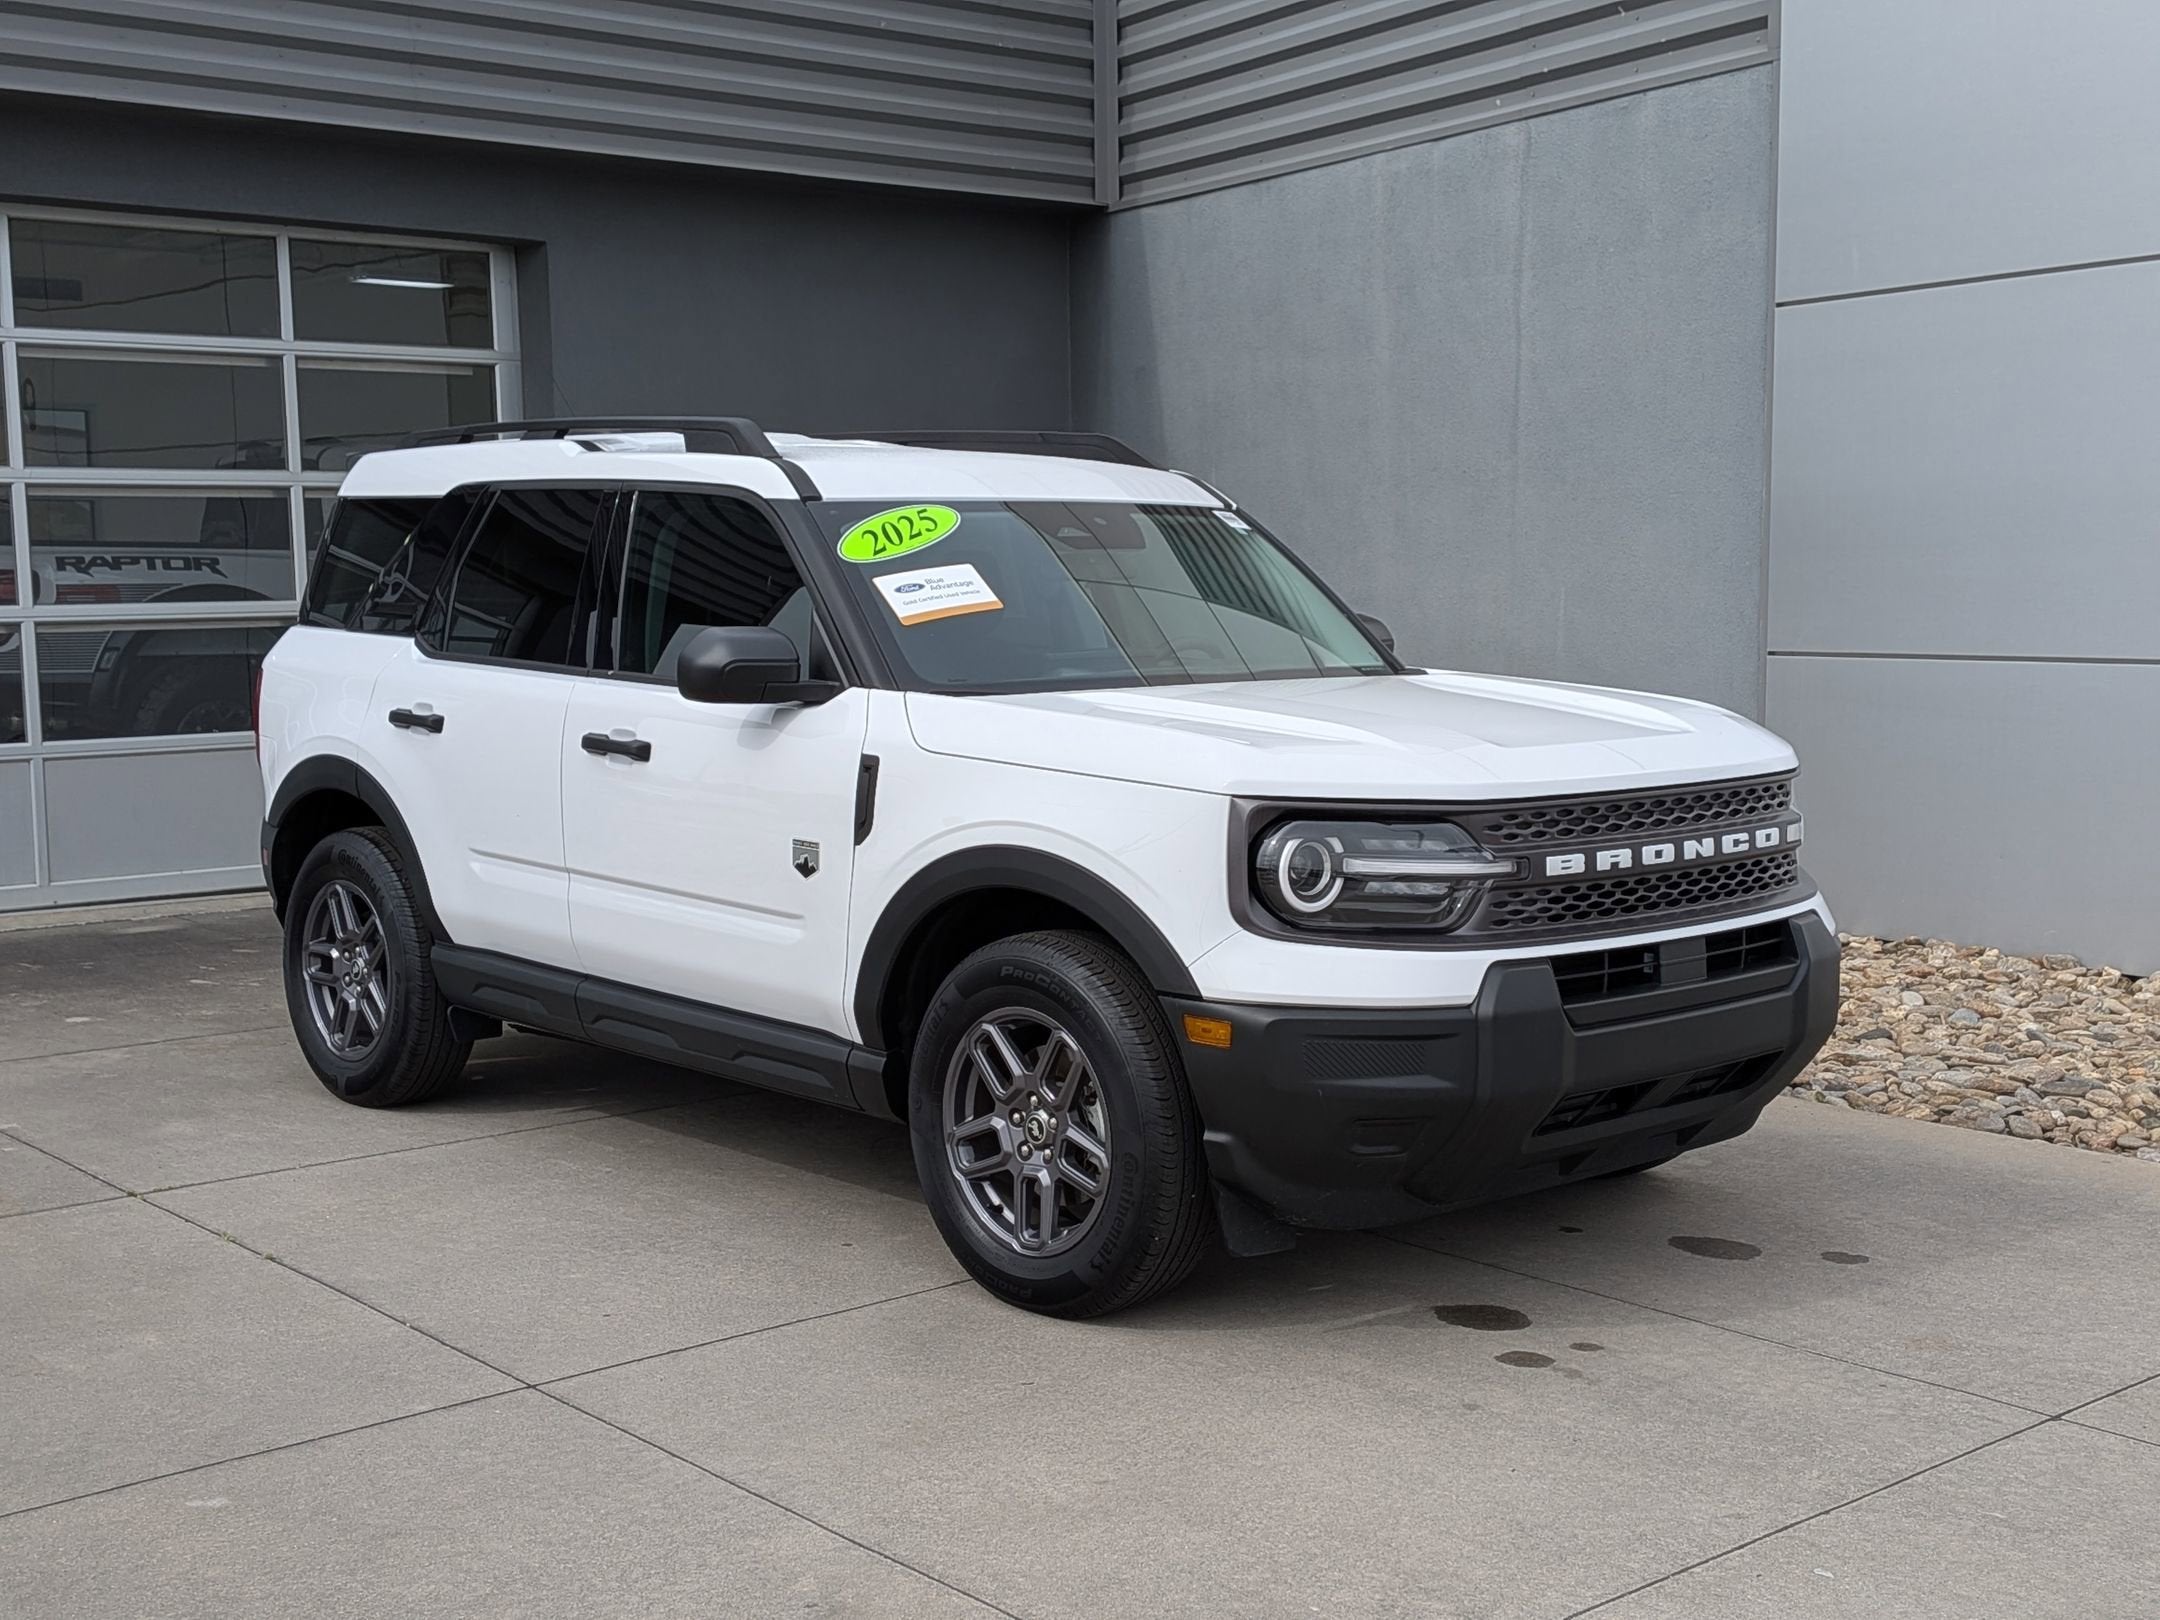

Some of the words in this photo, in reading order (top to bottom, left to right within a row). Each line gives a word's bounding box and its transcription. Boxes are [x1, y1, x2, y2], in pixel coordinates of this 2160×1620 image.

[861, 508, 938, 556] 2025
[54, 556, 228, 579] RAPTOR
[925, 577, 944, 585] Blue
[930, 580, 974, 591] Advantage
[899, 583, 920, 593] Ford
[918, 595, 943, 603] Certified
[1546, 827, 1780, 877] BRONCO
